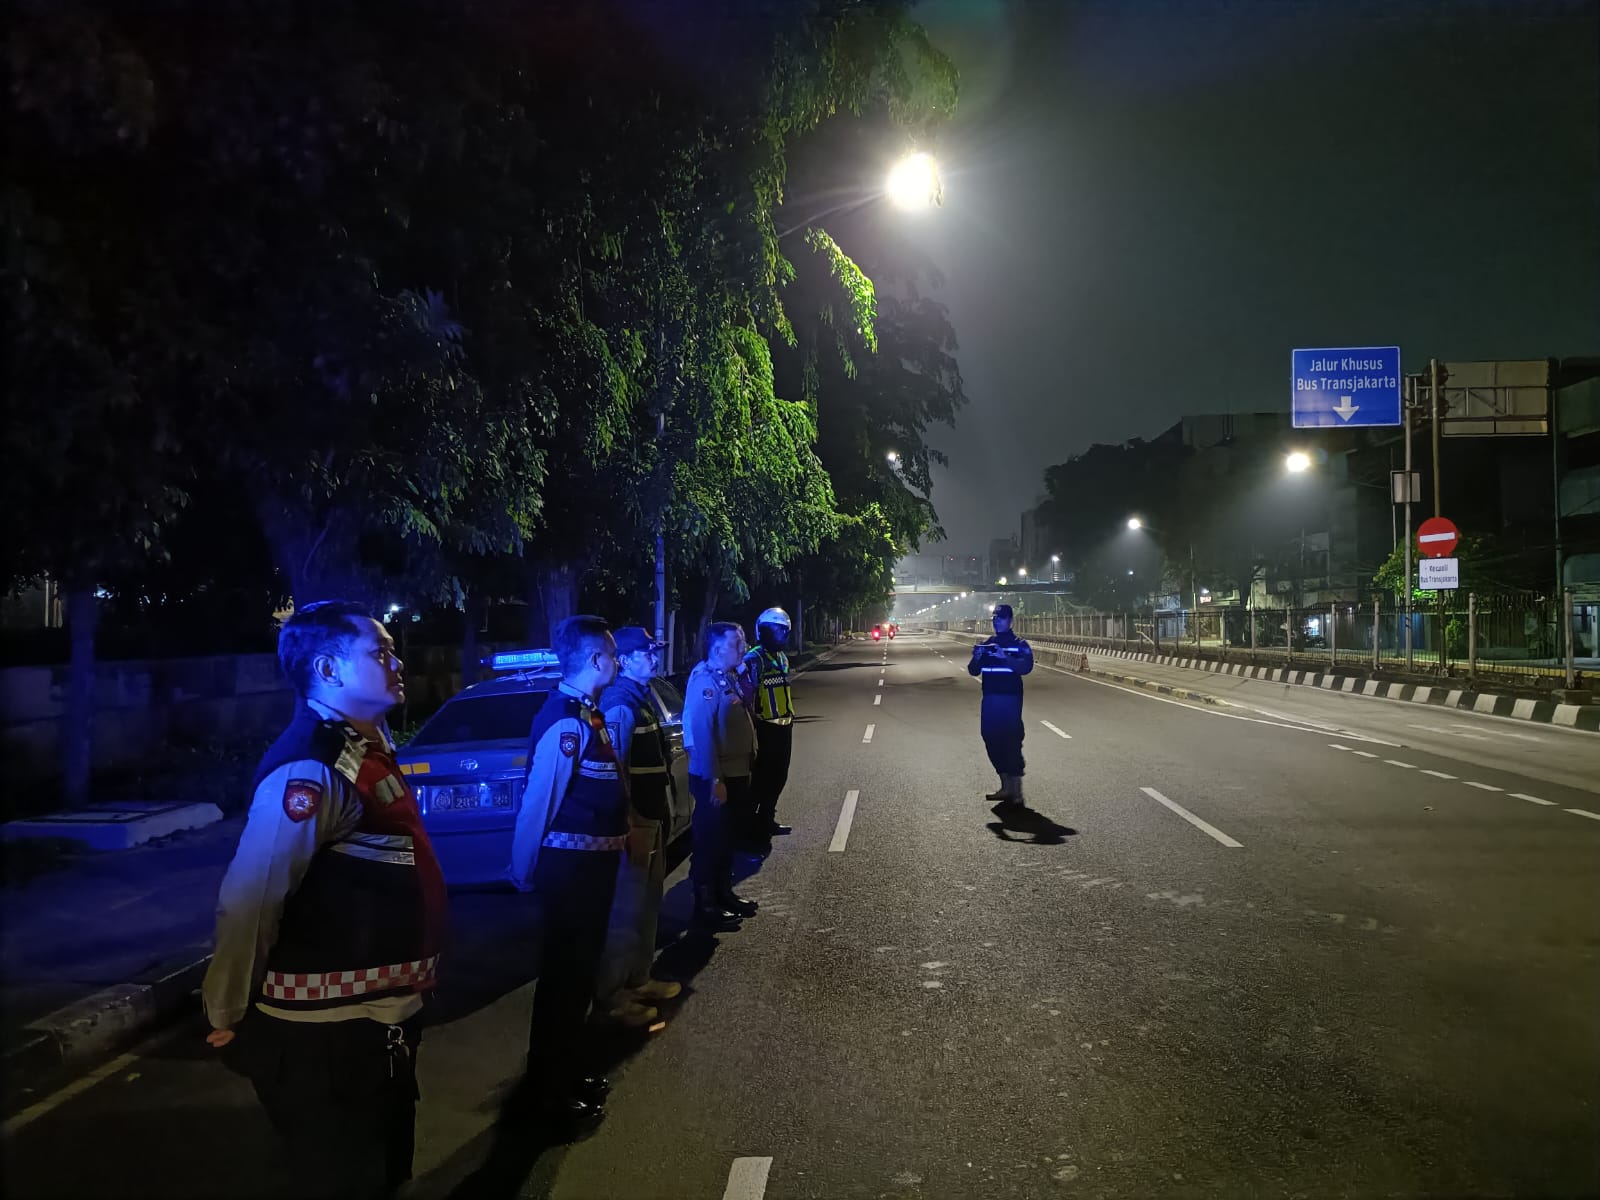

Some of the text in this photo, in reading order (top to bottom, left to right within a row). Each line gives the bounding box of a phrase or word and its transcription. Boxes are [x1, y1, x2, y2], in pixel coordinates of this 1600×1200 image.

[1310, 357, 1383, 372] Jalur Khusus
[1297, 375, 1396, 392] Bus Transjakarta
